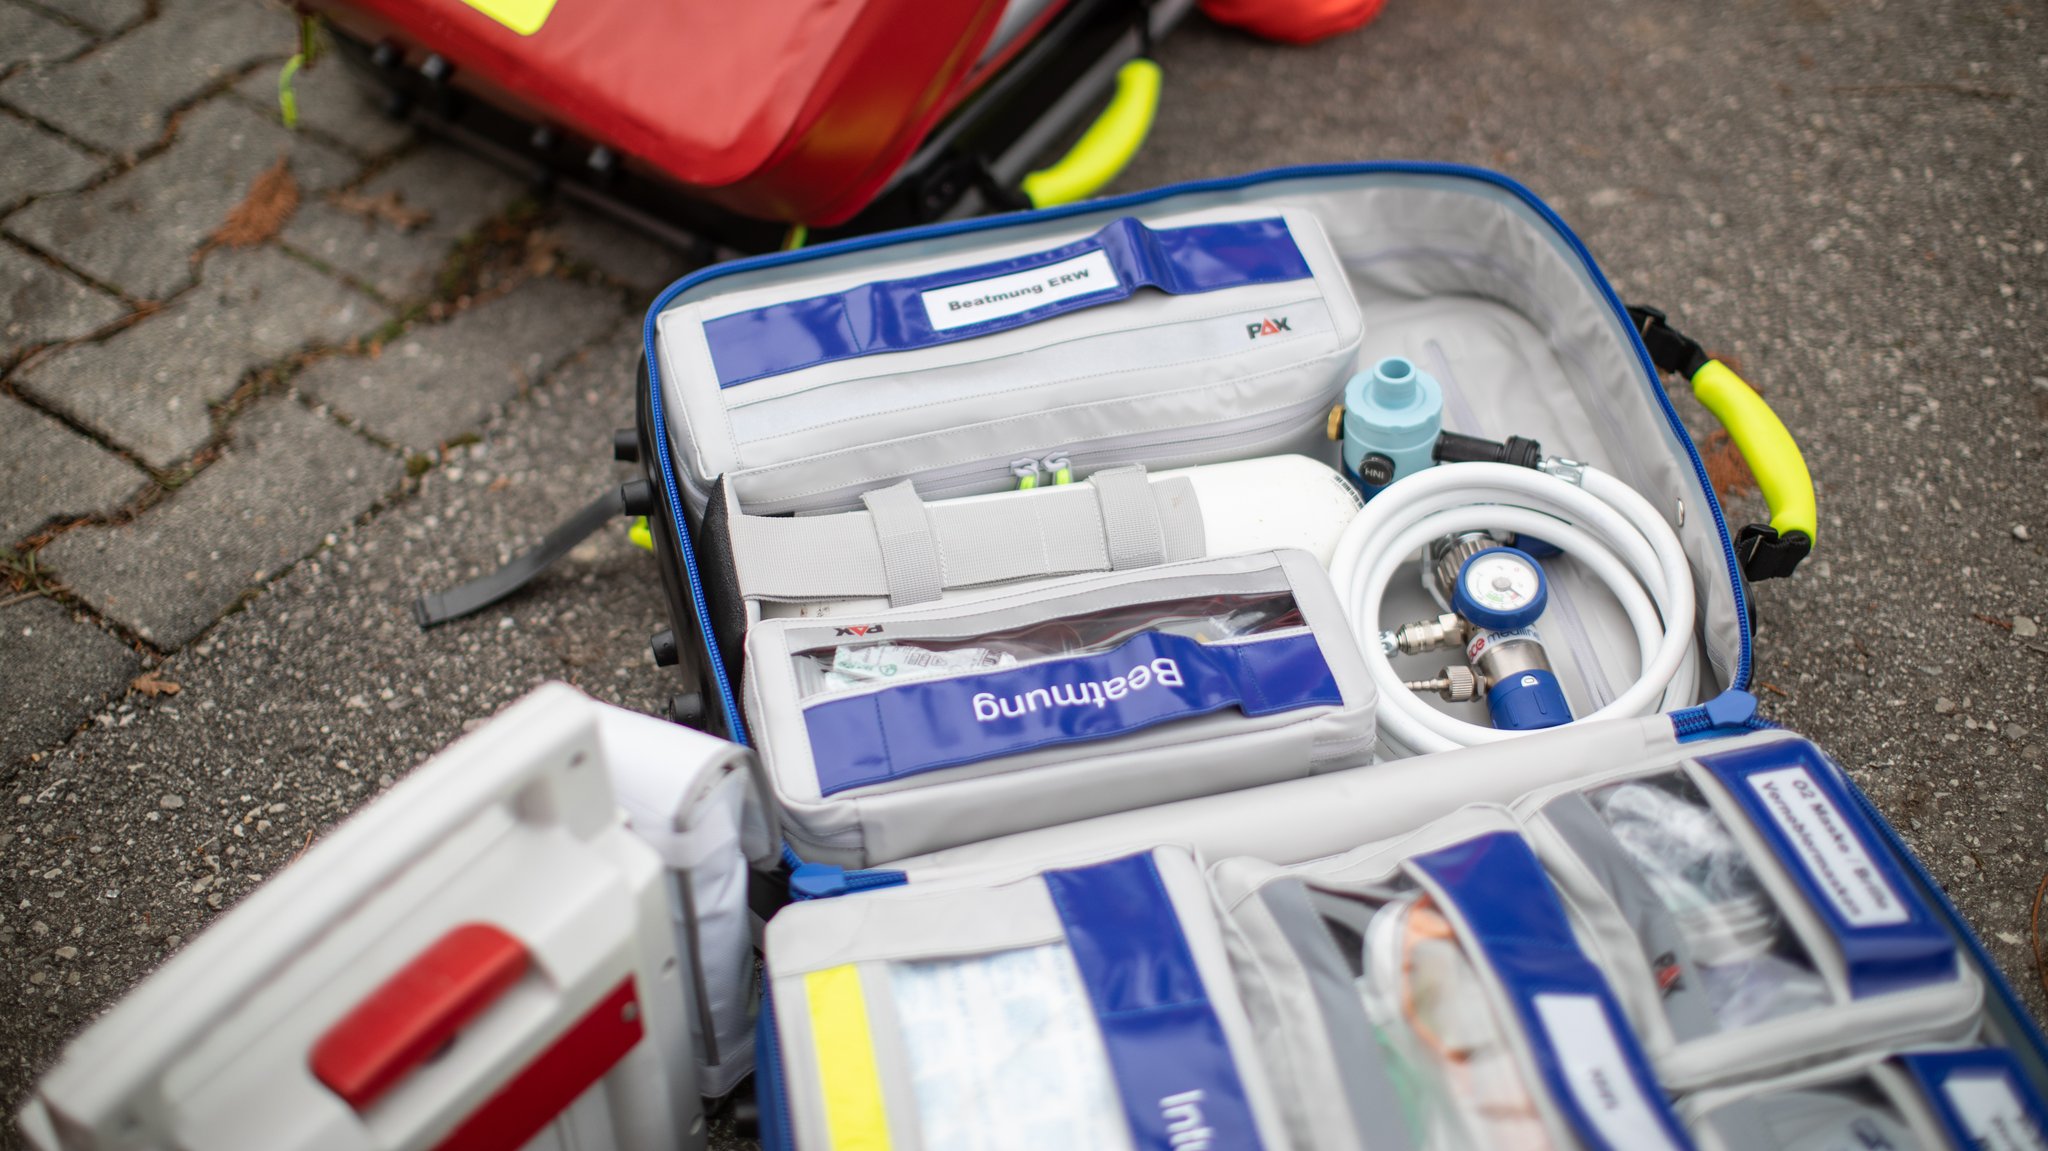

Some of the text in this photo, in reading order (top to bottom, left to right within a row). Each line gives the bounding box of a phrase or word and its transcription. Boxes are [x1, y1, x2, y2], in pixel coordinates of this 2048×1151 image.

[948, 269, 1090, 311] Beatmung ERW
[1246, 316, 1292, 340] PAX
[834, 624, 884, 636] PAX
[972, 657, 1184, 721] Beatmung
[1810, 802, 1849, 853] Maske
[1160, 1089, 1216, 1151] Int
